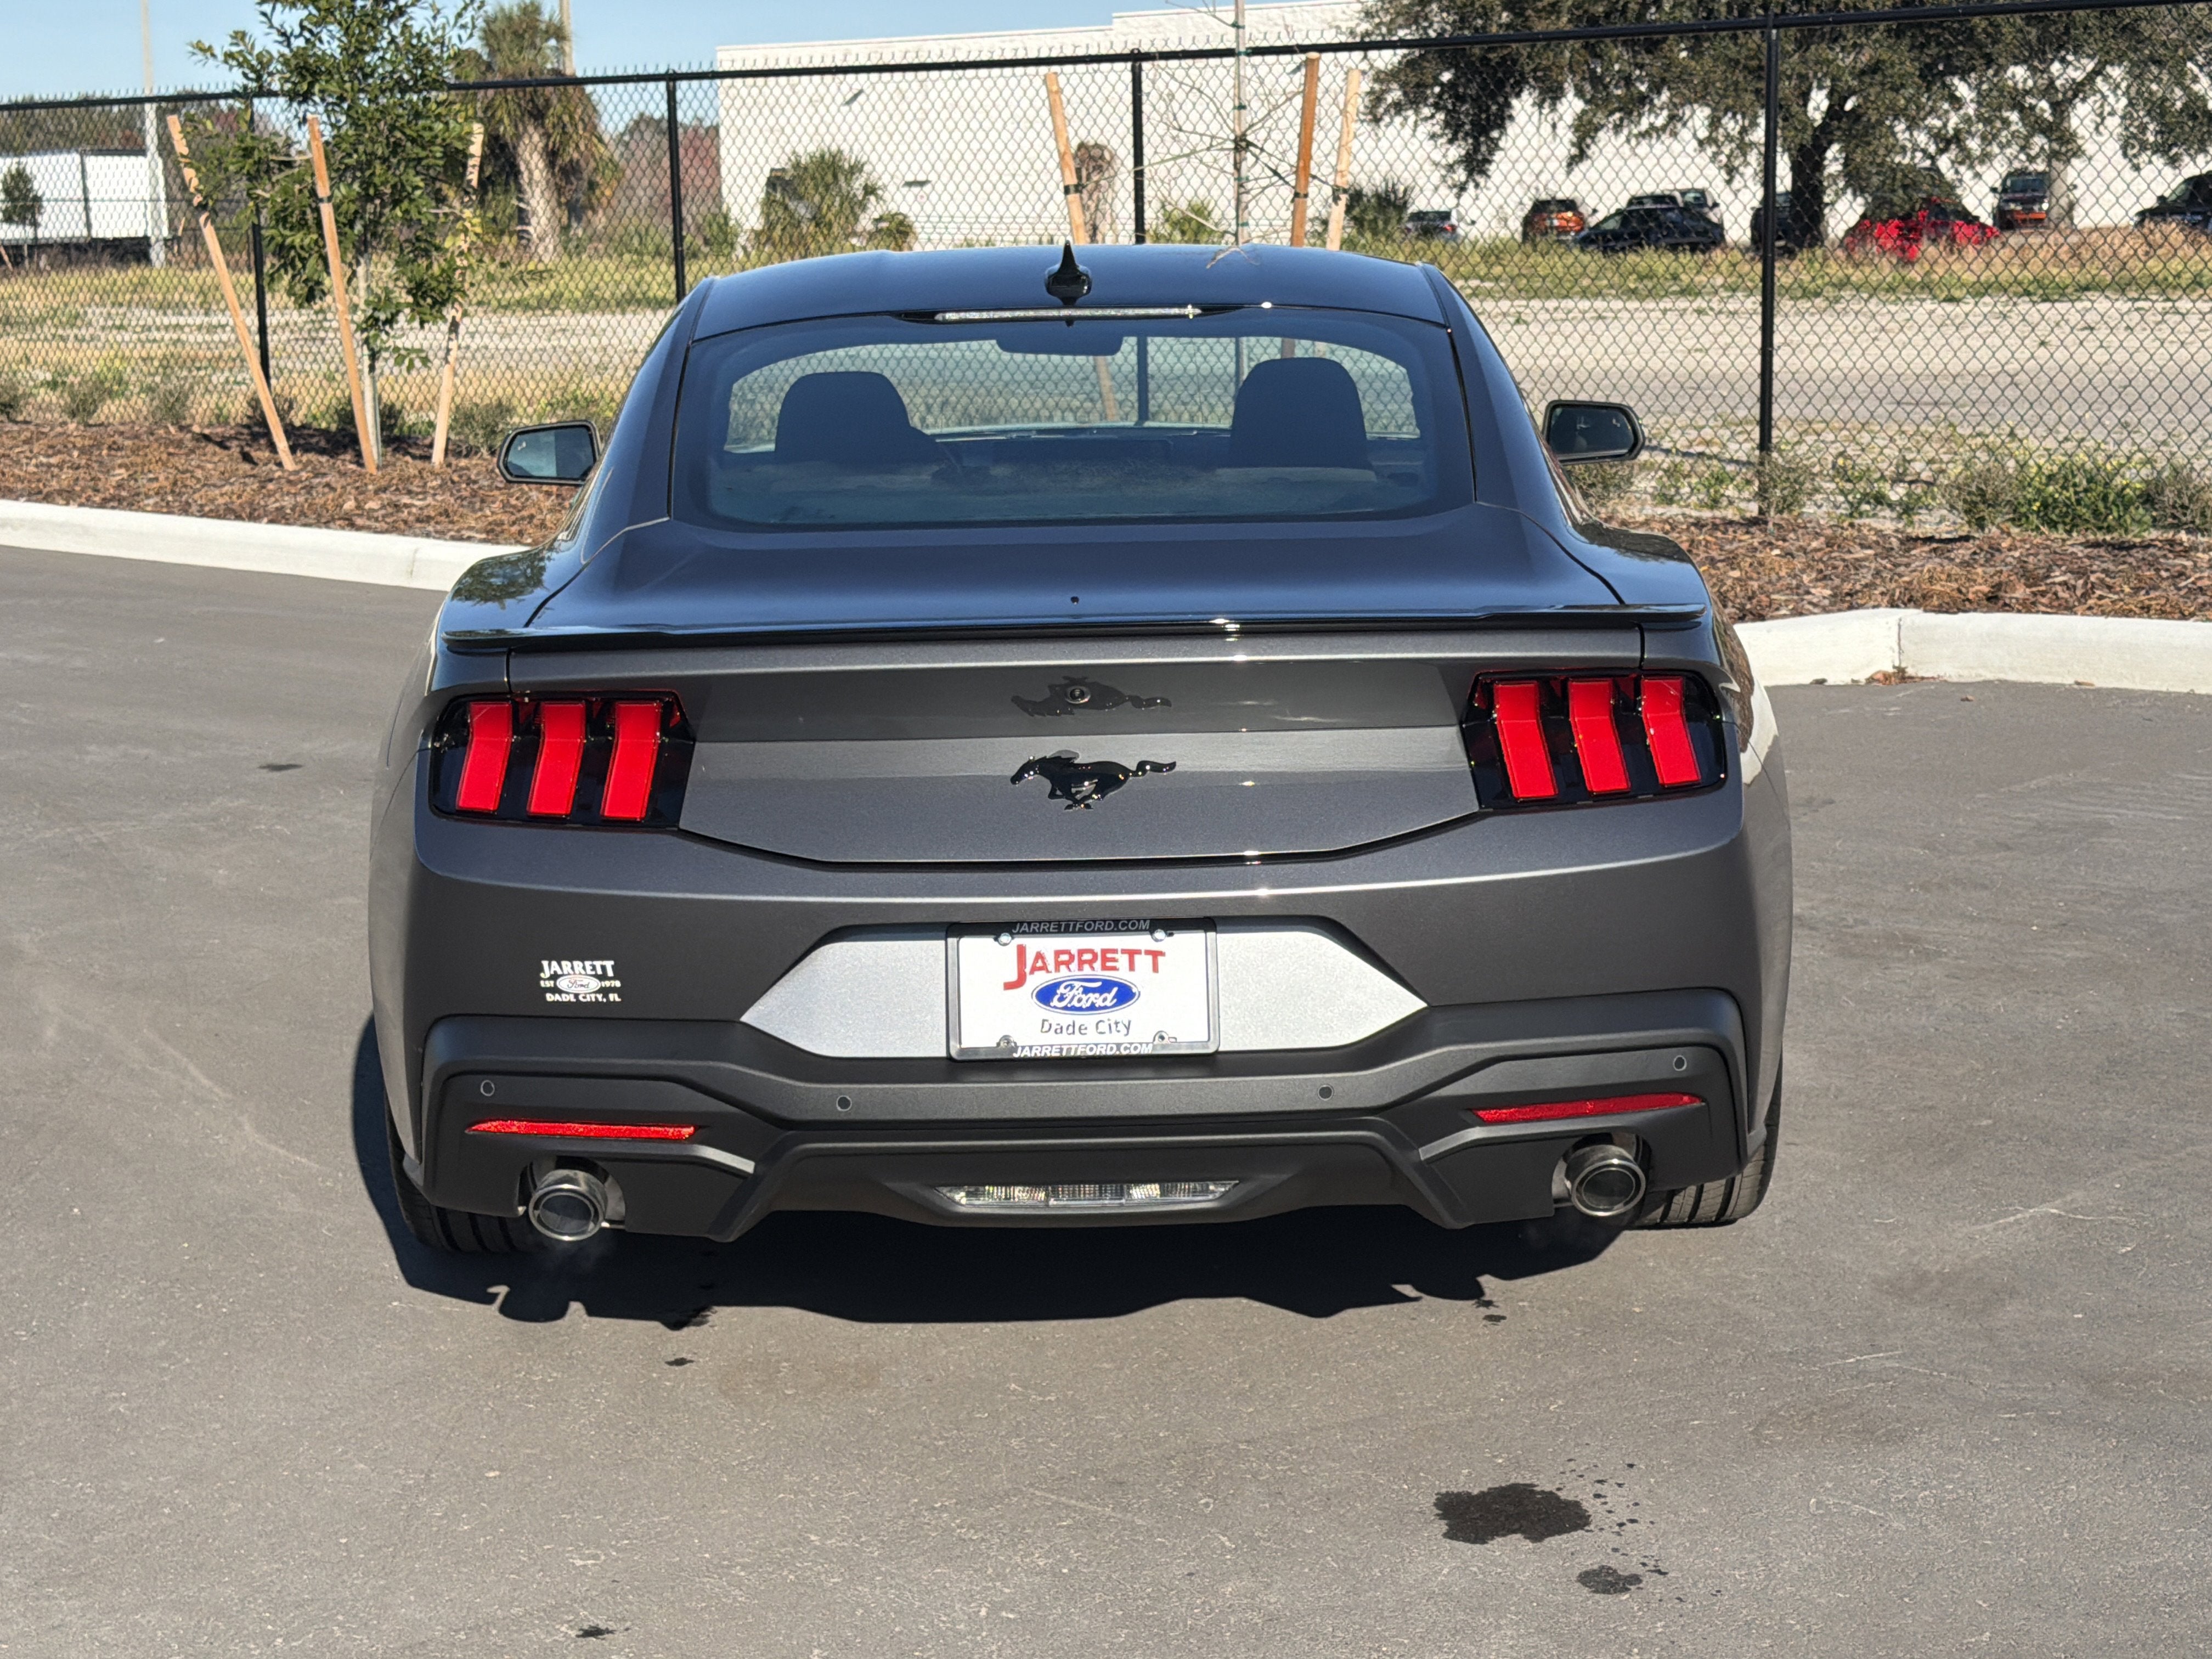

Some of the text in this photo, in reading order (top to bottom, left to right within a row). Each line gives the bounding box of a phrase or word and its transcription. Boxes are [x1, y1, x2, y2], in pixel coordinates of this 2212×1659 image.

[1012, 919, 1150, 933] JARRETTFORD.COM
[540, 960, 614, 978] JARRETT
[1003, 944, 1166, 991] JARRETT
[567, 979, 591, 989] Ford
[545, 992, 577, 1002] DADE
[578, 992, 607, 1003] CITY,
[1049, 980, 1119, 1009] Ford
[1040, 1018, 1132, 1037] Dade City
[1012, 1043, 1153, 1058] JARRETTFORD.COM
